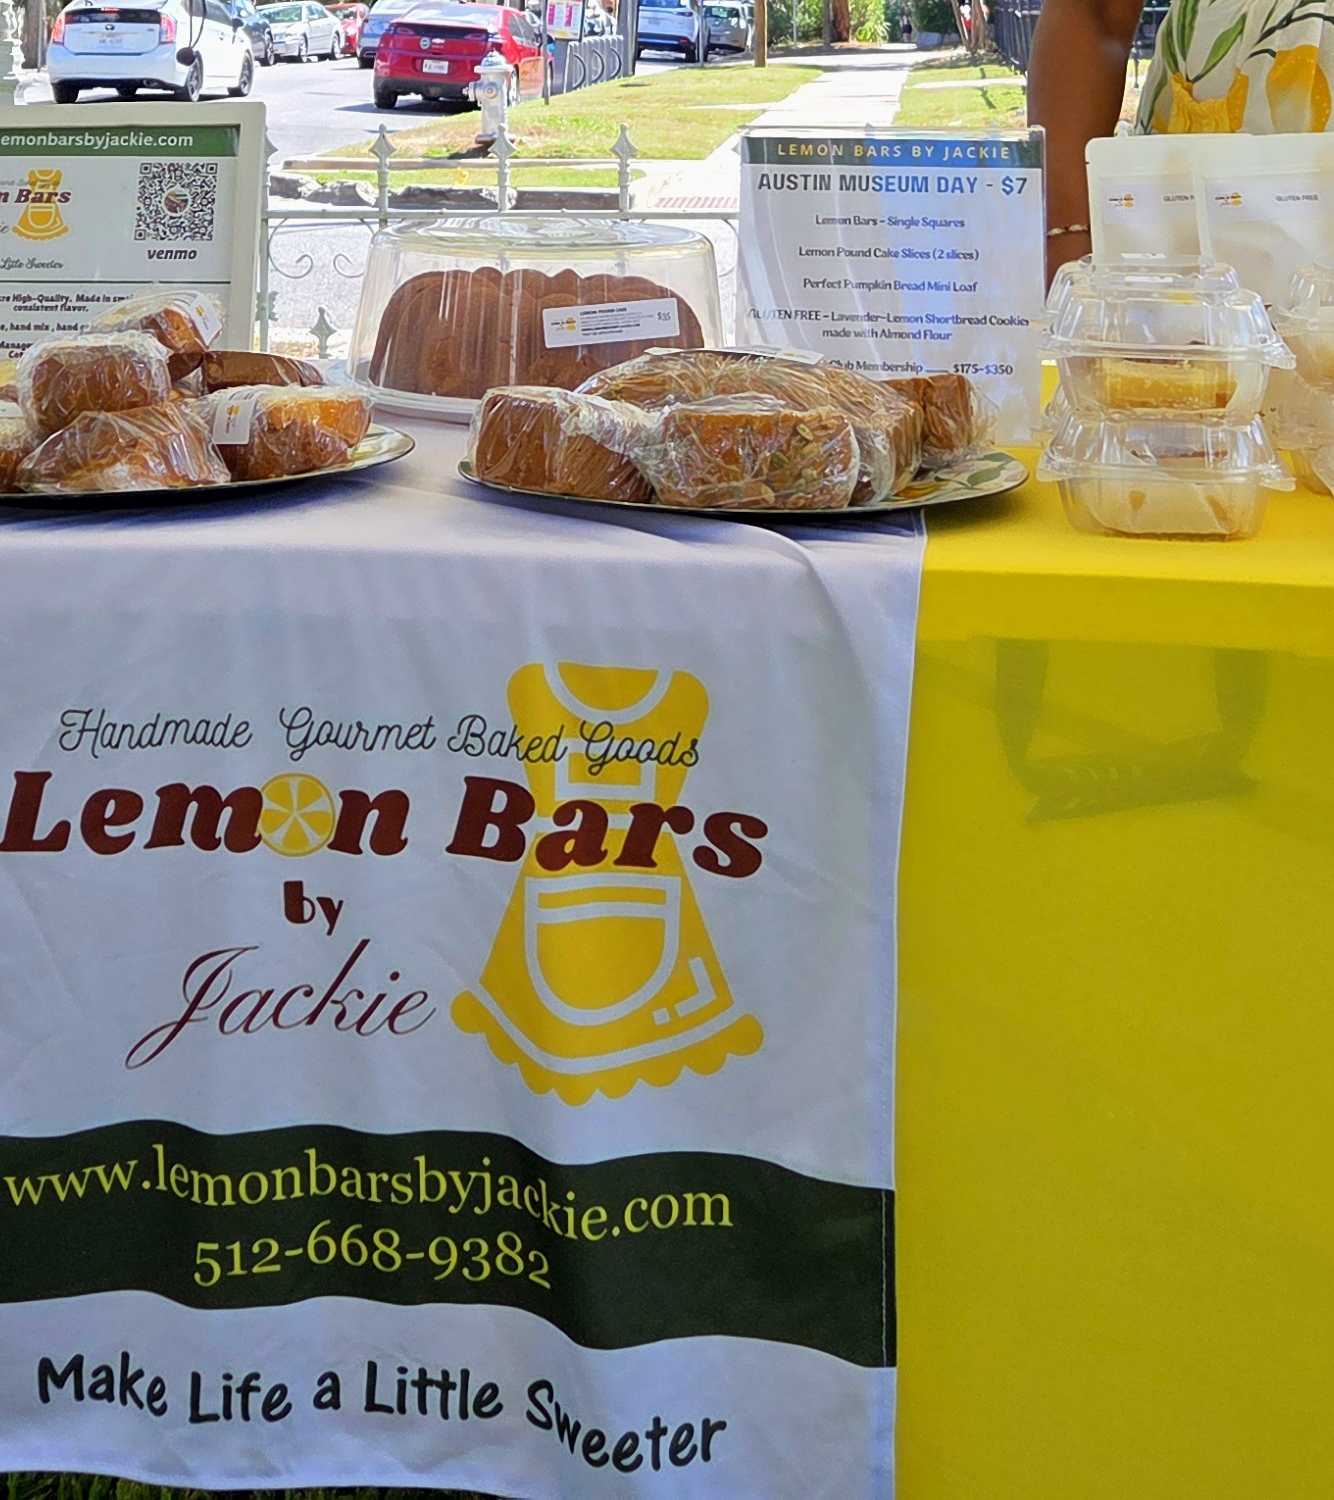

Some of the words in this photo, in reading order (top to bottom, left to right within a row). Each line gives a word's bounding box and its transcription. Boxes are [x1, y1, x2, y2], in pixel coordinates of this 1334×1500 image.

[778, 143, 844, 157] LEMON
[854, 144, 902, 158] BARS
[912, 145, 935, 158] BY
[943, 146, 1010, 160] JACKIE
[758, 173, 832, 192] AUSTIN
[839, 174, 929, 193] MUSEUM
[936, 176, 978, 194] DAY
[1001, 175, 1028, 196] $7
[14, 188, 72, 204] Bars
[816, 215, 852, 226] Lemon
[854, 215, 878, 227] Bars
[887, 216, 920, 230] Single
[921, 216, 965, 230] Squares
[147, 248, 198, 260] venmo
[798, 246, 835, 258] Lemon
[837, 247, 872, 258] Pound
[873, 247, 899, 259] Cake
[901, 247, 930, 260] Slices
[932, 248, 945, 261] (2
[946, 248, 980, 261] slices)
[803, 278, 842, 290] Perfect
[843, 279, 892, 293] Pumpkin
[893, 280, 925, 292] Bread
[927, 280, 951, 292] Mini
[952, 282, 978, 292] Loaf
[12, 293, 72, 304] High-Quality.
[75, 293, 100, 303] Made
[101, 293, 111, 303] in
[13, 302, 59, 312] consistent
[60, 303, 89, 312] flavor.
[657, 311, 672, 322] $35
[793, 309, 822, 321] FREE
[831, 311, 923, 324] Lavender-Lemon
[925, 314, 987, 325] Shortbread
[9, 322, 32, 331] hand
[33, 323, 50, 331] mix
[56, 322, 79, 331] hand
[822, 327, 852, 338] made
[853, 328, 878, 339] with
[880, 328, 921, 340] Almond
[923, 329, 953, 340] Flour
[856, 361, 923, 375] Membership
[953, 363, 1013, 375] $175-$350
[59, 708, 253, 760] Handmade
[279, 706, 436, 761] Gourmet
[447, 714, 568, 764] Baked
[580, 720, 700, 776] Goods
[445, 775, 769, 878] Bars
[283, 880, 344, 936] by
[124, 938, 437, 1070] Jackie
[3, 1143, 734, 1242] www.lemonbarsbyjackie.com
[193, 1220, 552, 1290] 512-668-9382
[37, 1351, 168, 1417] Make
[189, 1370, 293, 1425] Life
[312, 1370, 342, 1412] a
[365, 1360, 504, 1420] Little
[526, 1377, 727, 1474] Sweeter
